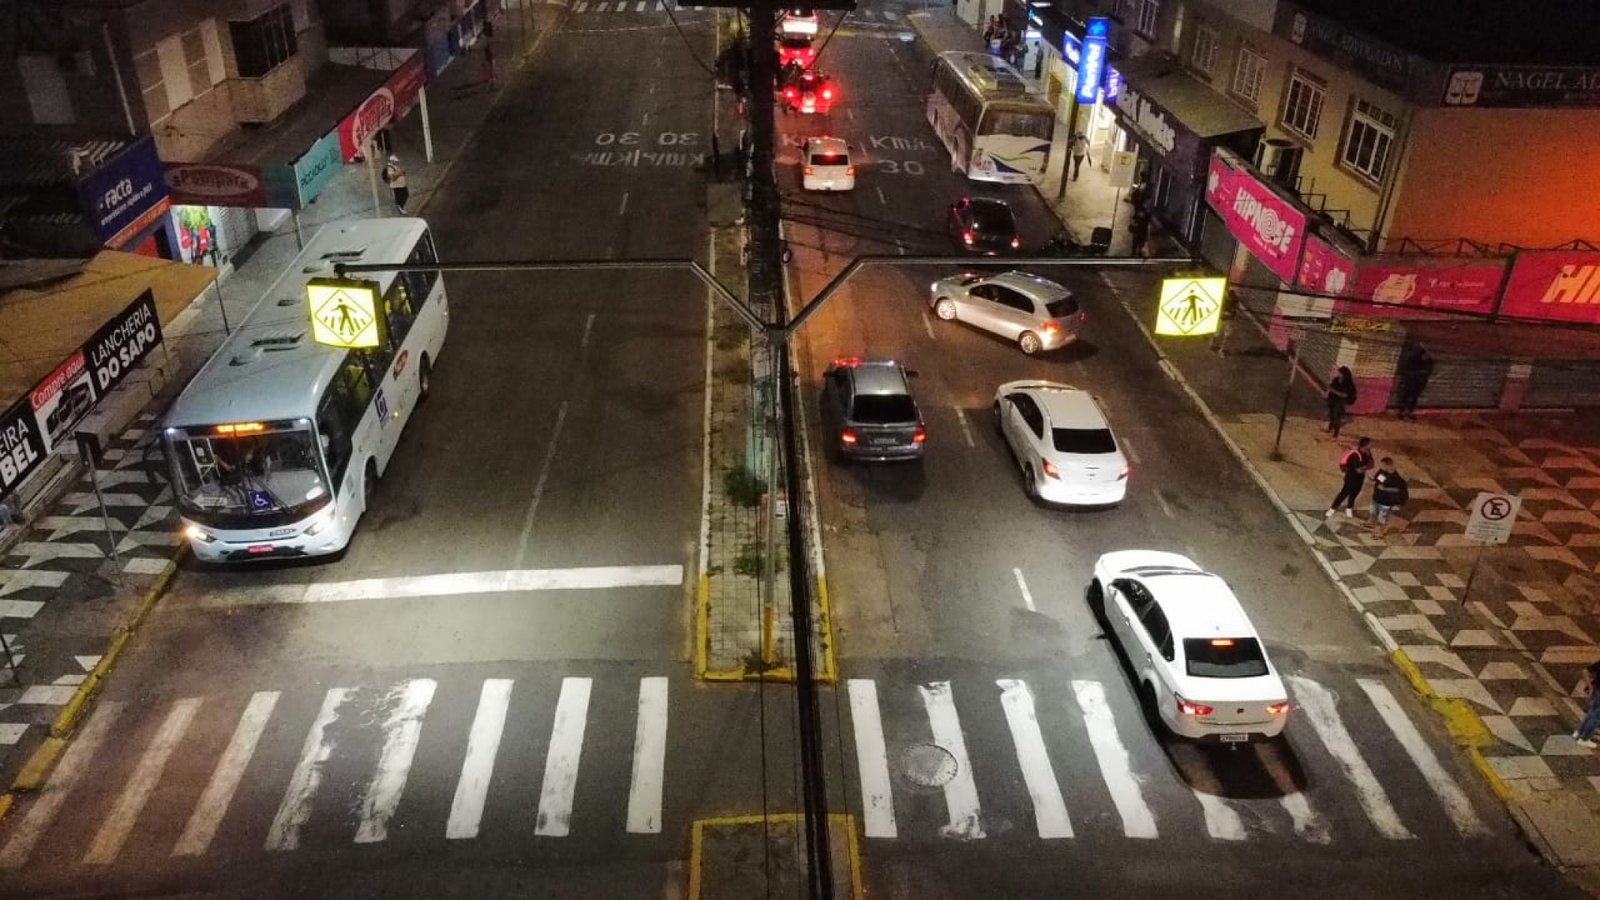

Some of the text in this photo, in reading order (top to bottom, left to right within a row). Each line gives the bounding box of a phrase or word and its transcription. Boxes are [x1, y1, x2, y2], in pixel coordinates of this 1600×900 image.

[876, 158, 925, 176] 30
[1233, 186, 1295, 255] HIPNOSE
[91, 303, 152, 368] LANCHERIA
[97, 322, 156, 391] DO SAPO
[31, 374, 66, 409] Compre
